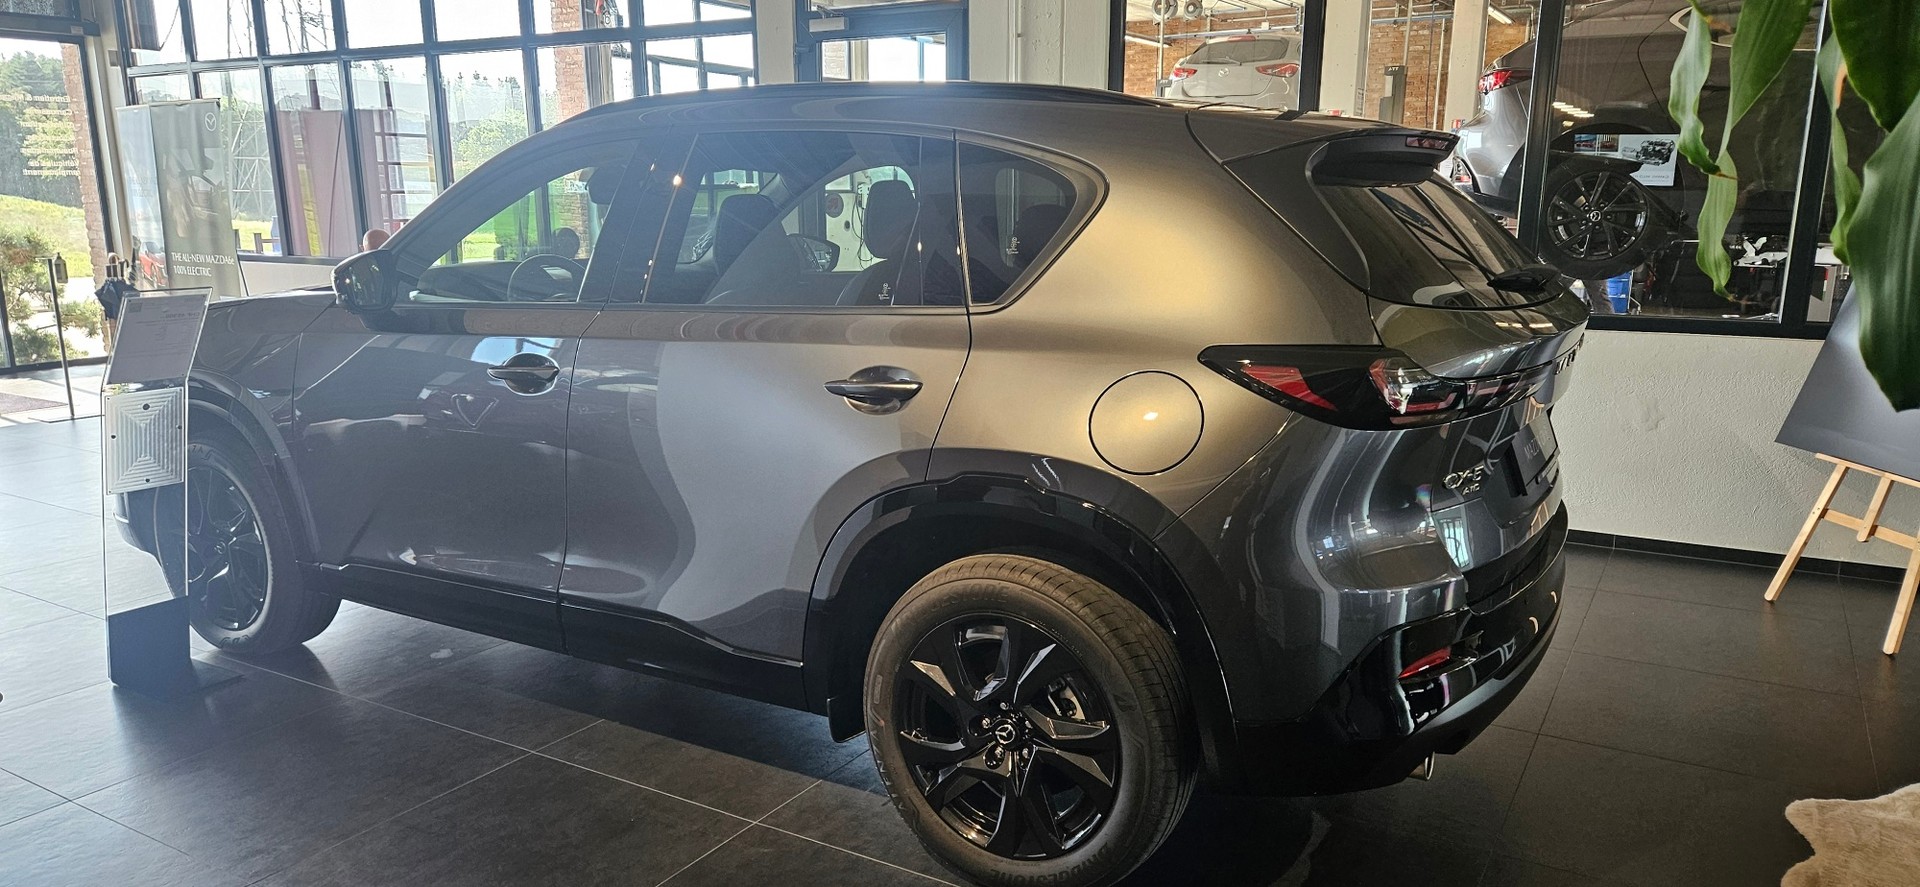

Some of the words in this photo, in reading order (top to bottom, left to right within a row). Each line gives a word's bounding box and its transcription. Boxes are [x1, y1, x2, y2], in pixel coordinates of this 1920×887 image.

[171, 252, 182, 262] THE
[182, 253, 205, 264] ALL-NEW
[206, 254, 234, 265] MAZDA6e
[174, 266, 186, 274] 100%
[186, 266, 212, 276] ELECTRIC
[1443, 465, 1484, 490] CX-5
[990, 841, 1109, 887] BRIDGESTONE
